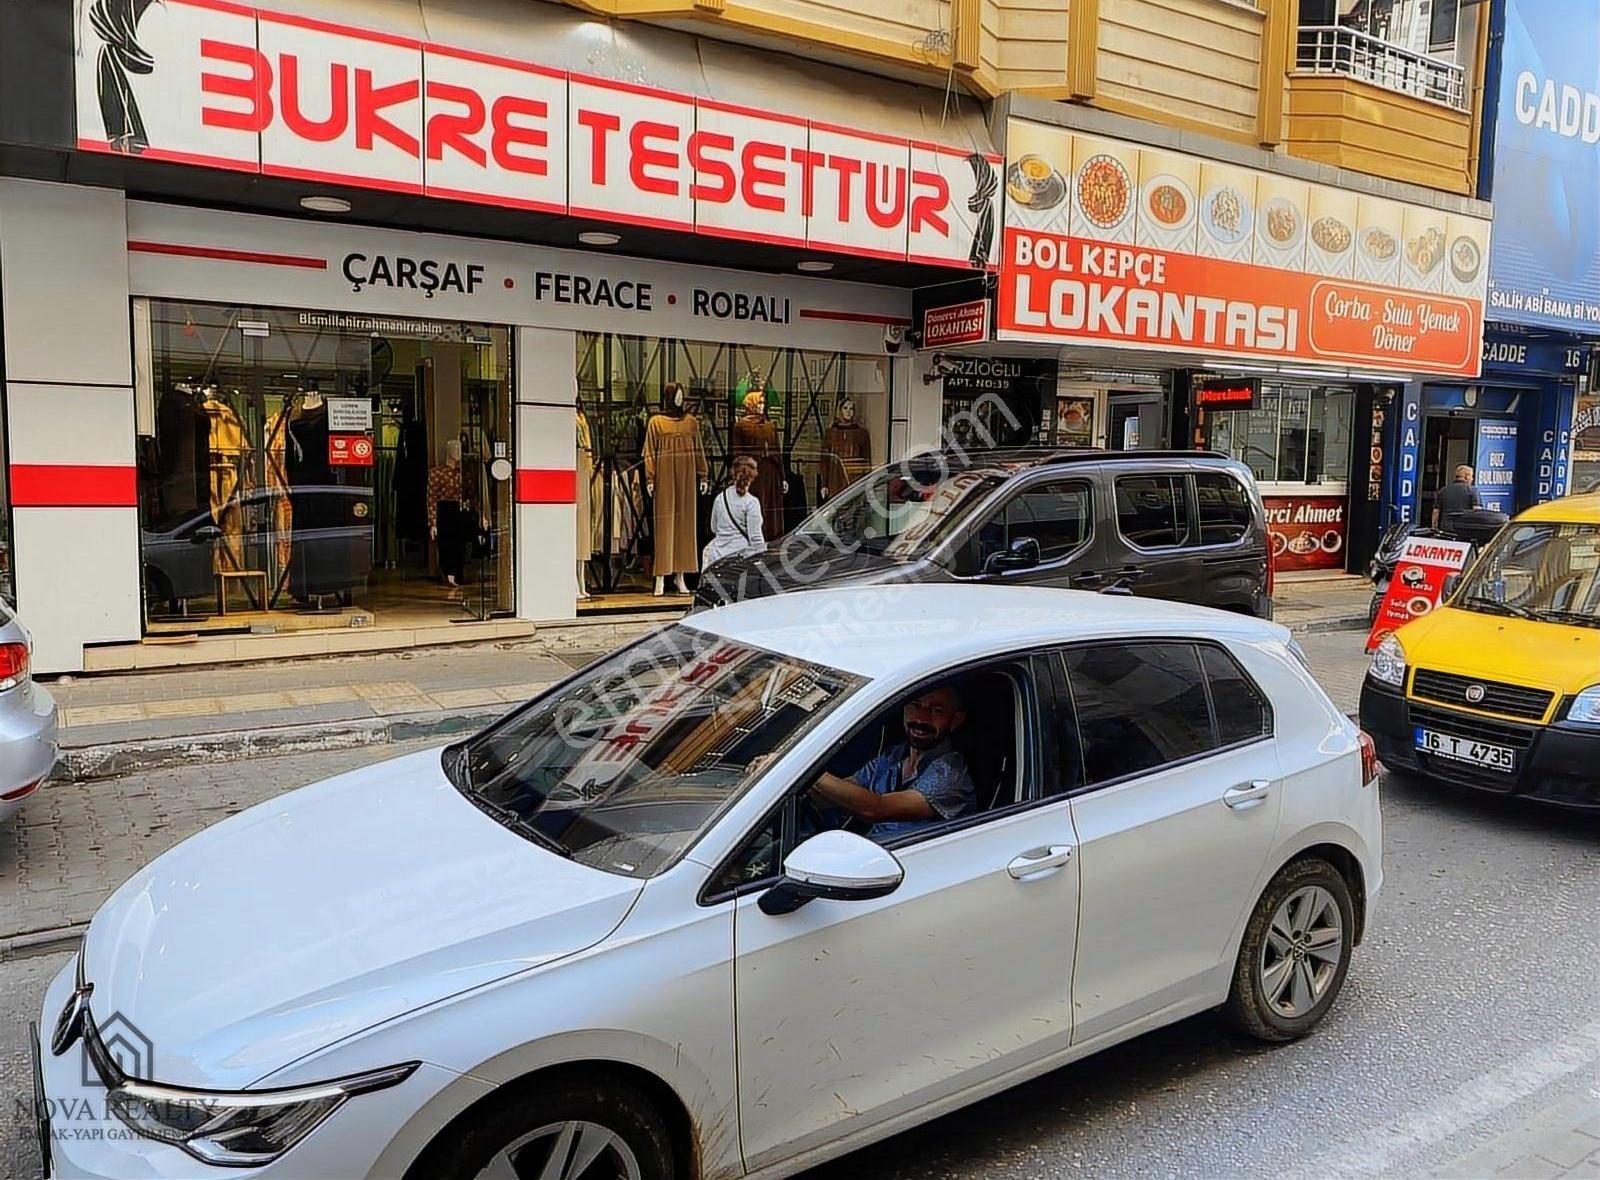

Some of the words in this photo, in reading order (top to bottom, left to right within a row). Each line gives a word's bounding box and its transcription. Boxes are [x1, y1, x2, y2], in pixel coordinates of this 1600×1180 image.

[578, 109, 949, 238] TESETTUR
[1015, 234, 1073, 272] BOL
[1081, 244, 1166, 287] KEPÇE
[343, 253, 484, 298] ÇARŞAF
[535, 272, 652, 311] FERACE
[693, 289, 791, 324] ROBALI
[927, 317, 983, 338] LOKANTASI
[1014, 274, 1299, 352] LOKANTASI
[1325, 291, 1371, 323] Çorba
[1383, 299, 1414, 326] Sulu
[1417, 304, 1461, 334] Yemek
[1586, 305, 1600, 321] YO
[1373, 325, 1417, 352] Döner
[1482, 342, 1527, 363] CADDE
[1565, 350, 1580, 368] 16
[1400, 402, 1418, 523] CADDE
[1538, 430, 1554, 505] CADD
[1294, 505, 1343, 524] Ahmet
[1406, 544, 1463, 562] LOKANTA
[1425, 732, 1440, 749] 16
[1450, 738, 1461, 754] T
[1470, 744, 1512, 766] 4735
